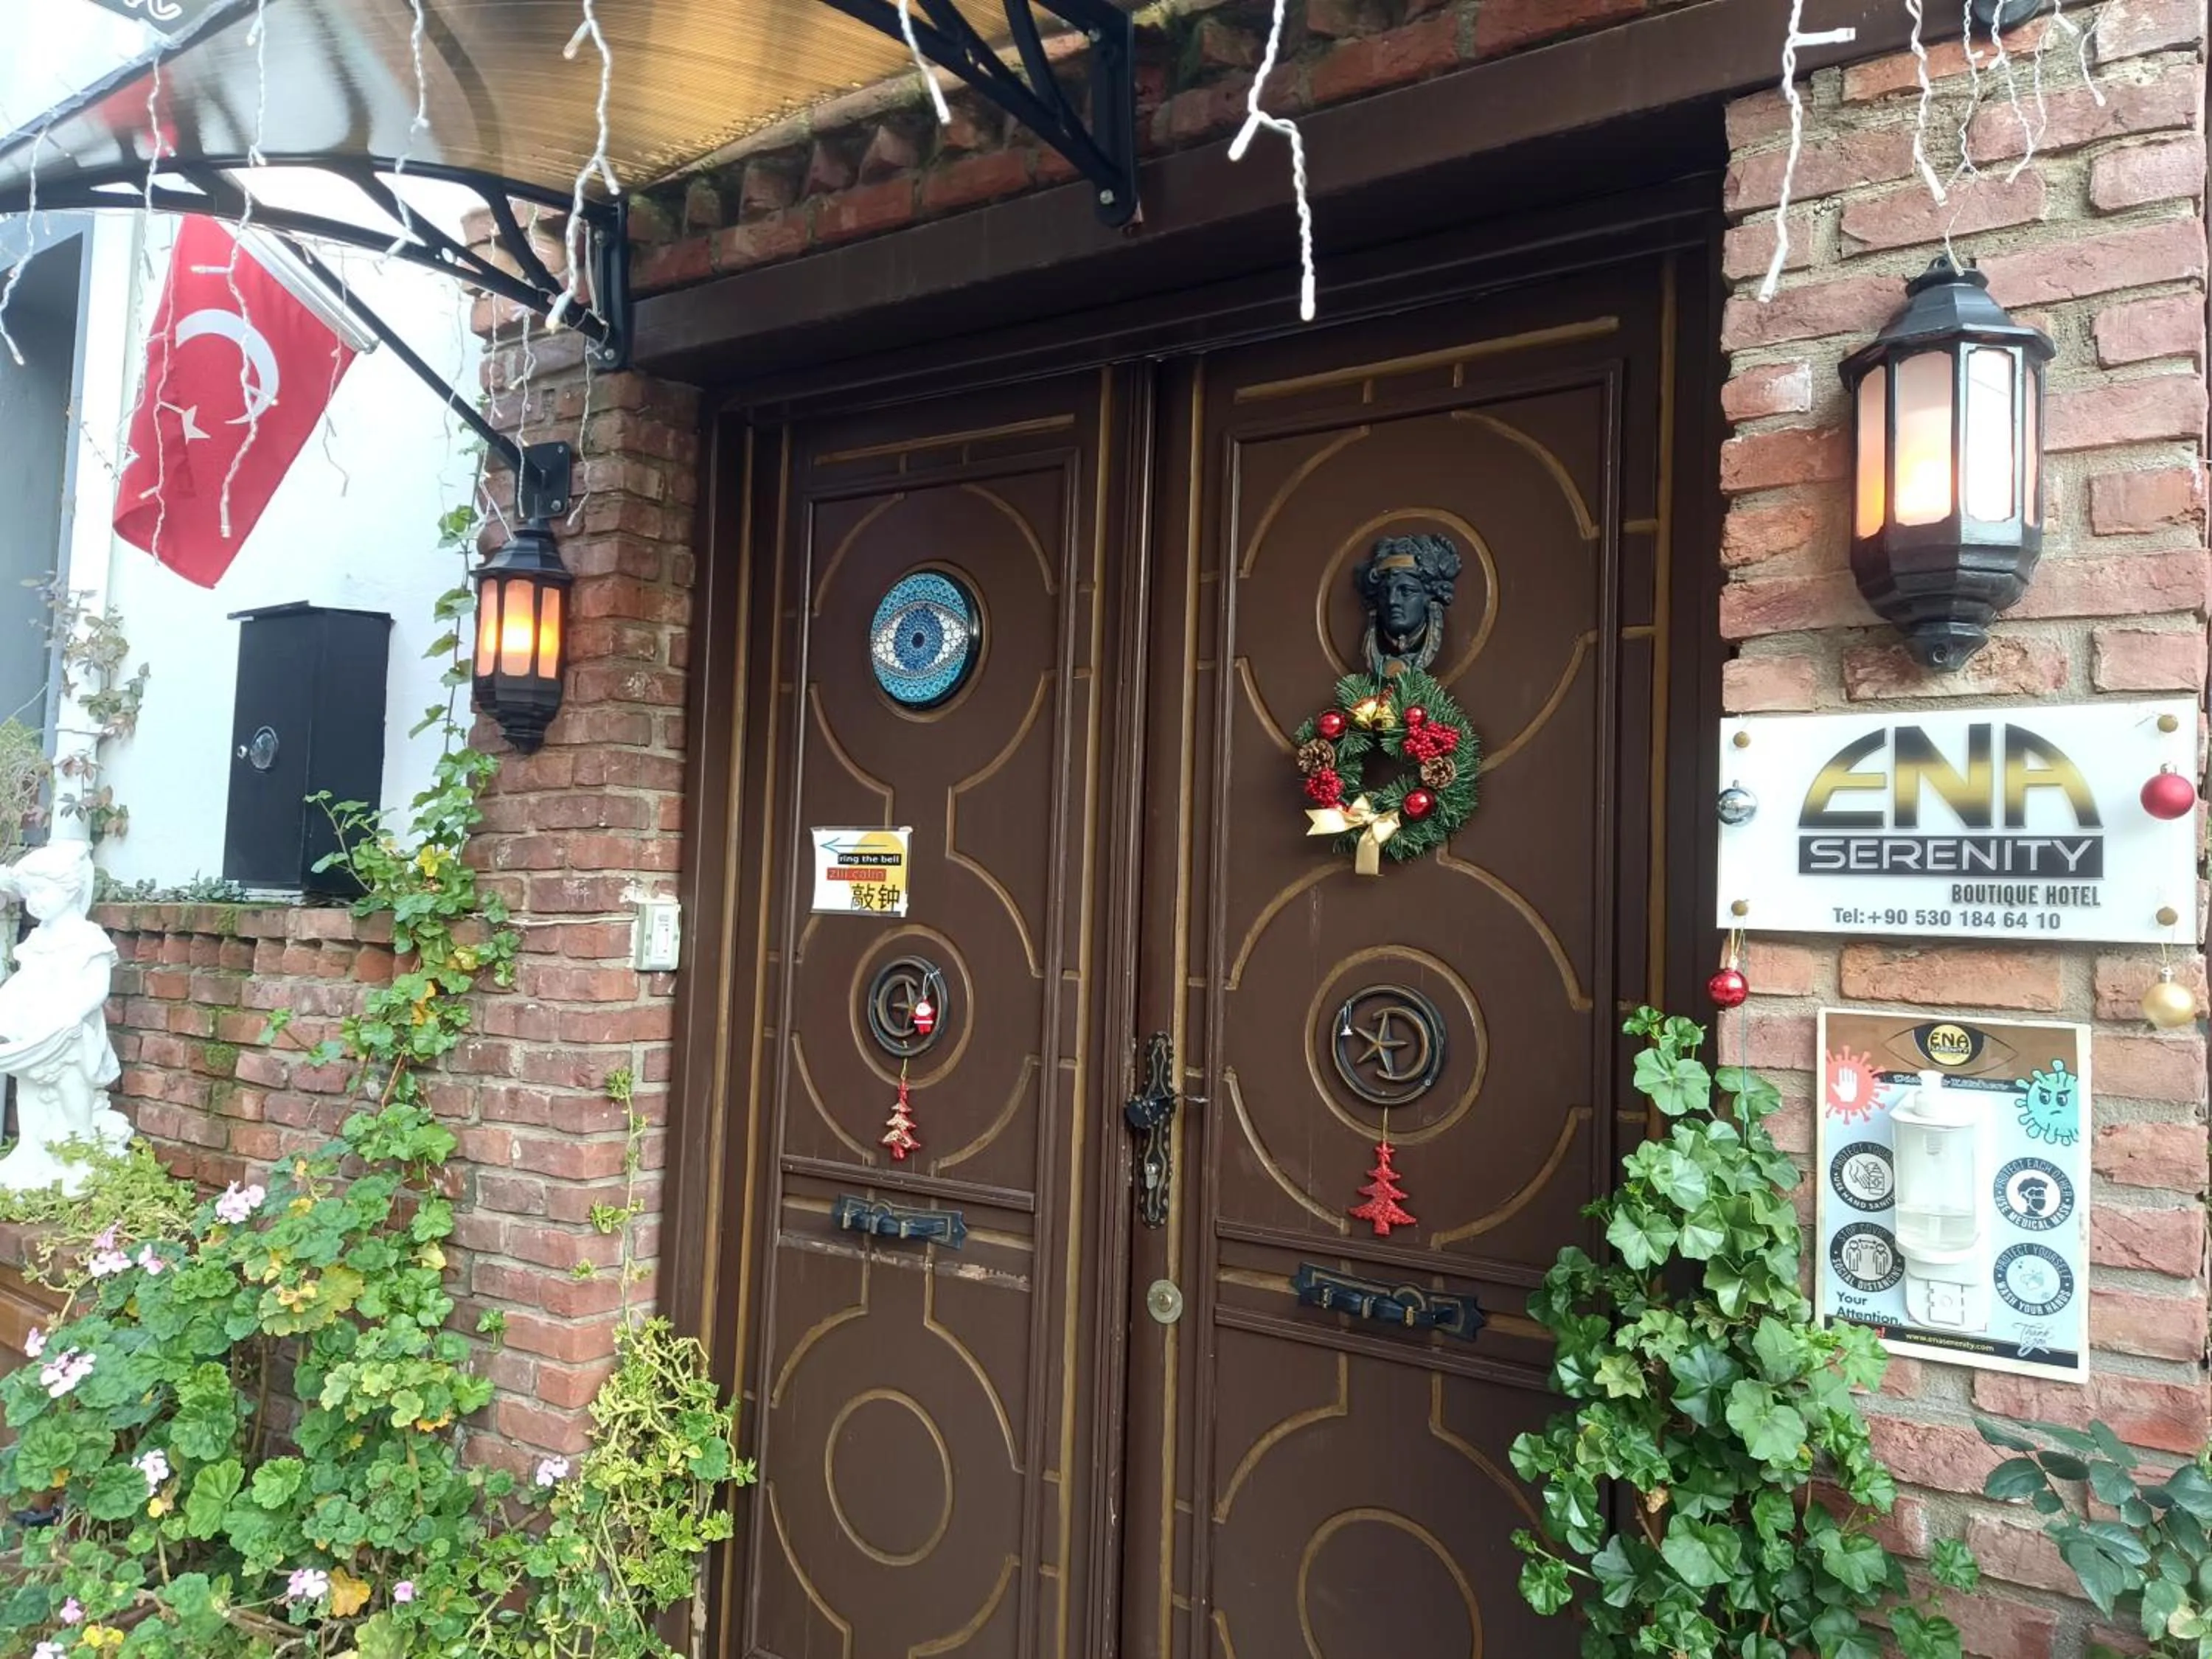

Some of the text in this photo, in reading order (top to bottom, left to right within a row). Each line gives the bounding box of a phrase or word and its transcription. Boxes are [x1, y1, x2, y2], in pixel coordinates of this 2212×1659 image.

[1798, 723, 2104, 830] ENA
[839, 855, 900, 865] ring the bell
[1809, 839, 2094, 873] SERENITY
[851, 883, 900, 912] 敲钟
[1951, 884, 2101, 907] BOUTIQUE HOTEL
[1915, 909, 1952, 927] 530
[1960, 911, 1997, 928] 184
[2003, 911, 2028, 929] 64
[2037, 913, 2062, 930] 10
[1930, 1032, 1969, 1048] ENA
[1995, 1160, 2025, 1189] PROTECT
[2026, 1158, 2053, 1173] EACH
[1841, 1192, 1867, 1209] HAND
[1995, 1194, 2072, 1231] USE MEDICAL MASK
[1995, 1244, 2028, 1273] PROTECT
[1832, 1258, 1903, 1292] SOCIAL DISTANCING
[1836, 1291, 1868, 1306] Your
[1996, 1281, 2071, 1315] WASH YOUR HANDS
